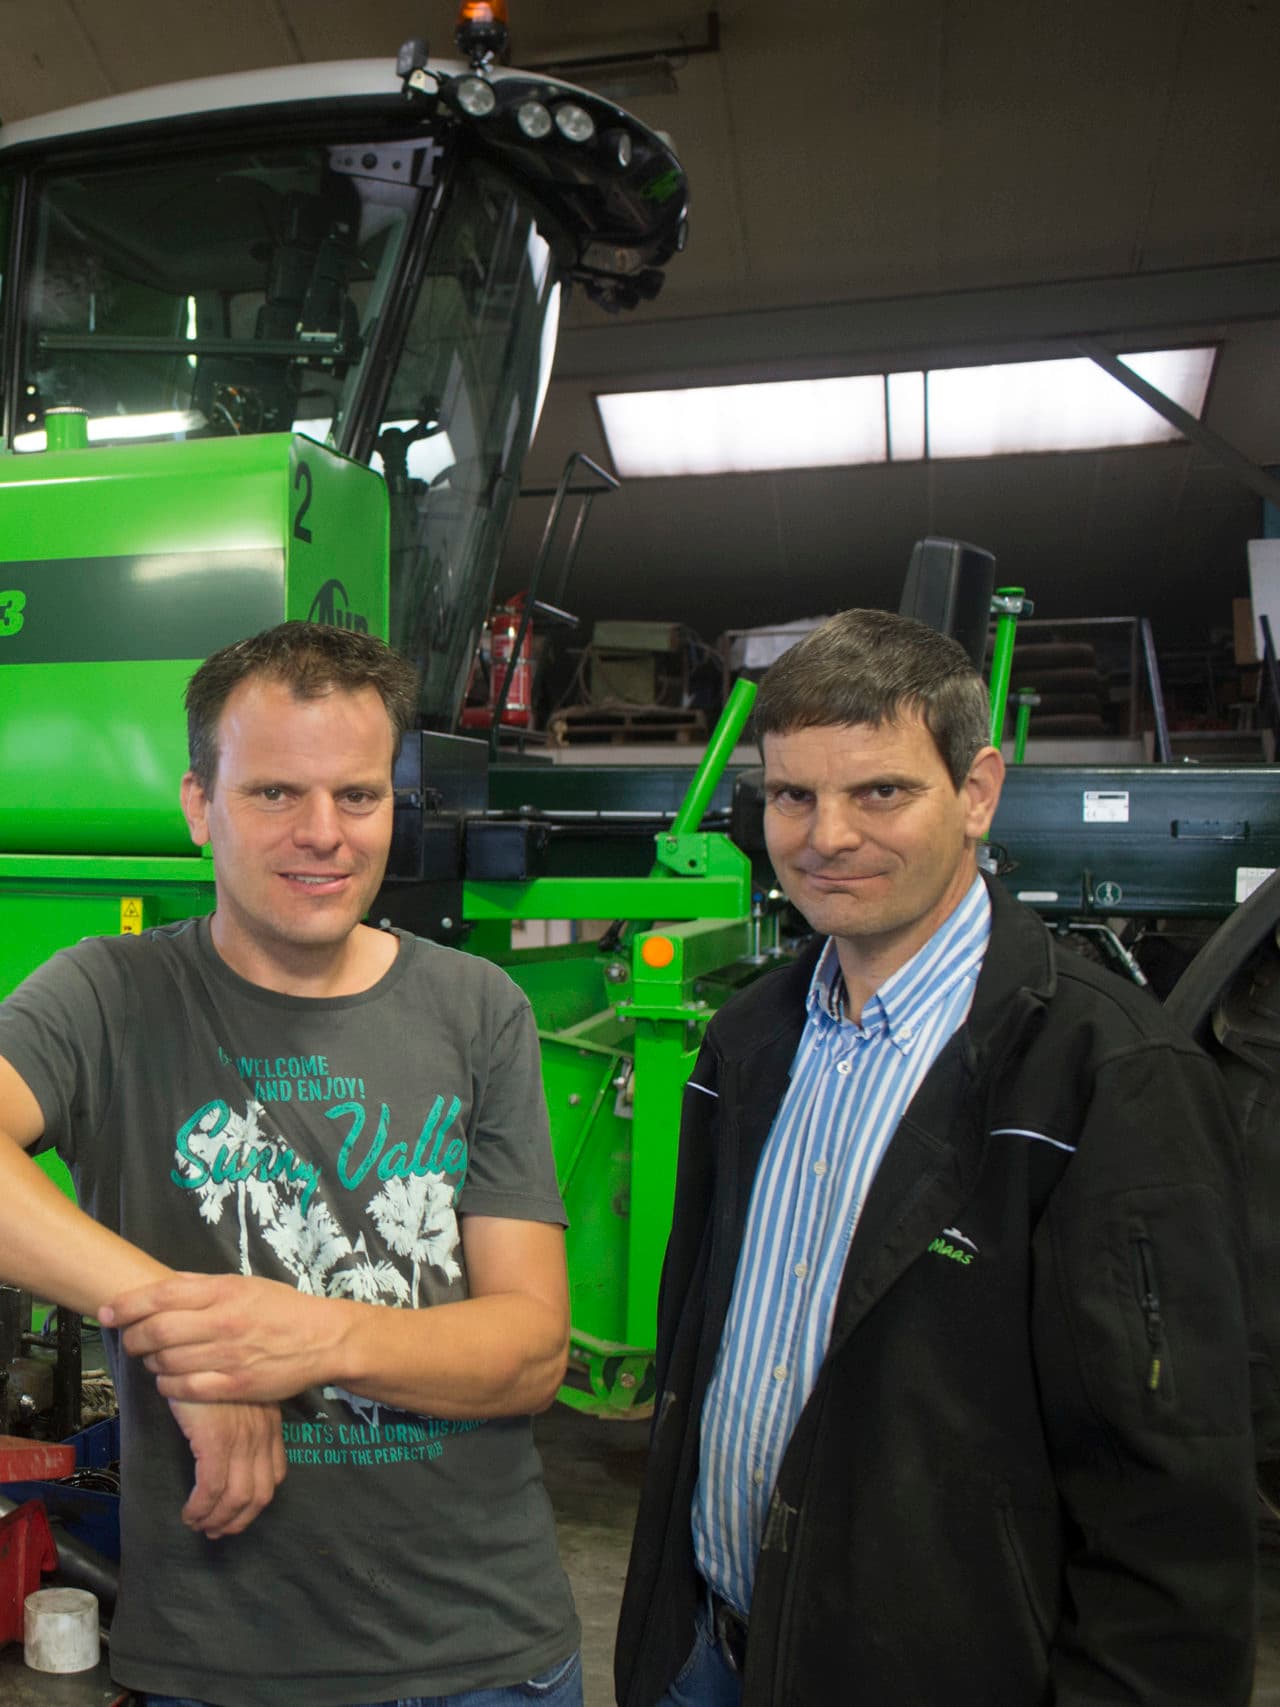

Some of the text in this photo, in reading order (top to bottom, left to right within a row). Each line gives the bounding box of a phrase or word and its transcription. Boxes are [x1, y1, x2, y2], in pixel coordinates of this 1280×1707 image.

[293, 460, 312, 545] 2
[235, 1055, 329, 1079] WELCOME
[254, 1076, 366, 1102] AND ENJOY!
[323, 1448, 348, 1465] OUT
[350, 1448, 374, 1466] THE
[374, 1445, 425, 1465] PERFECT
